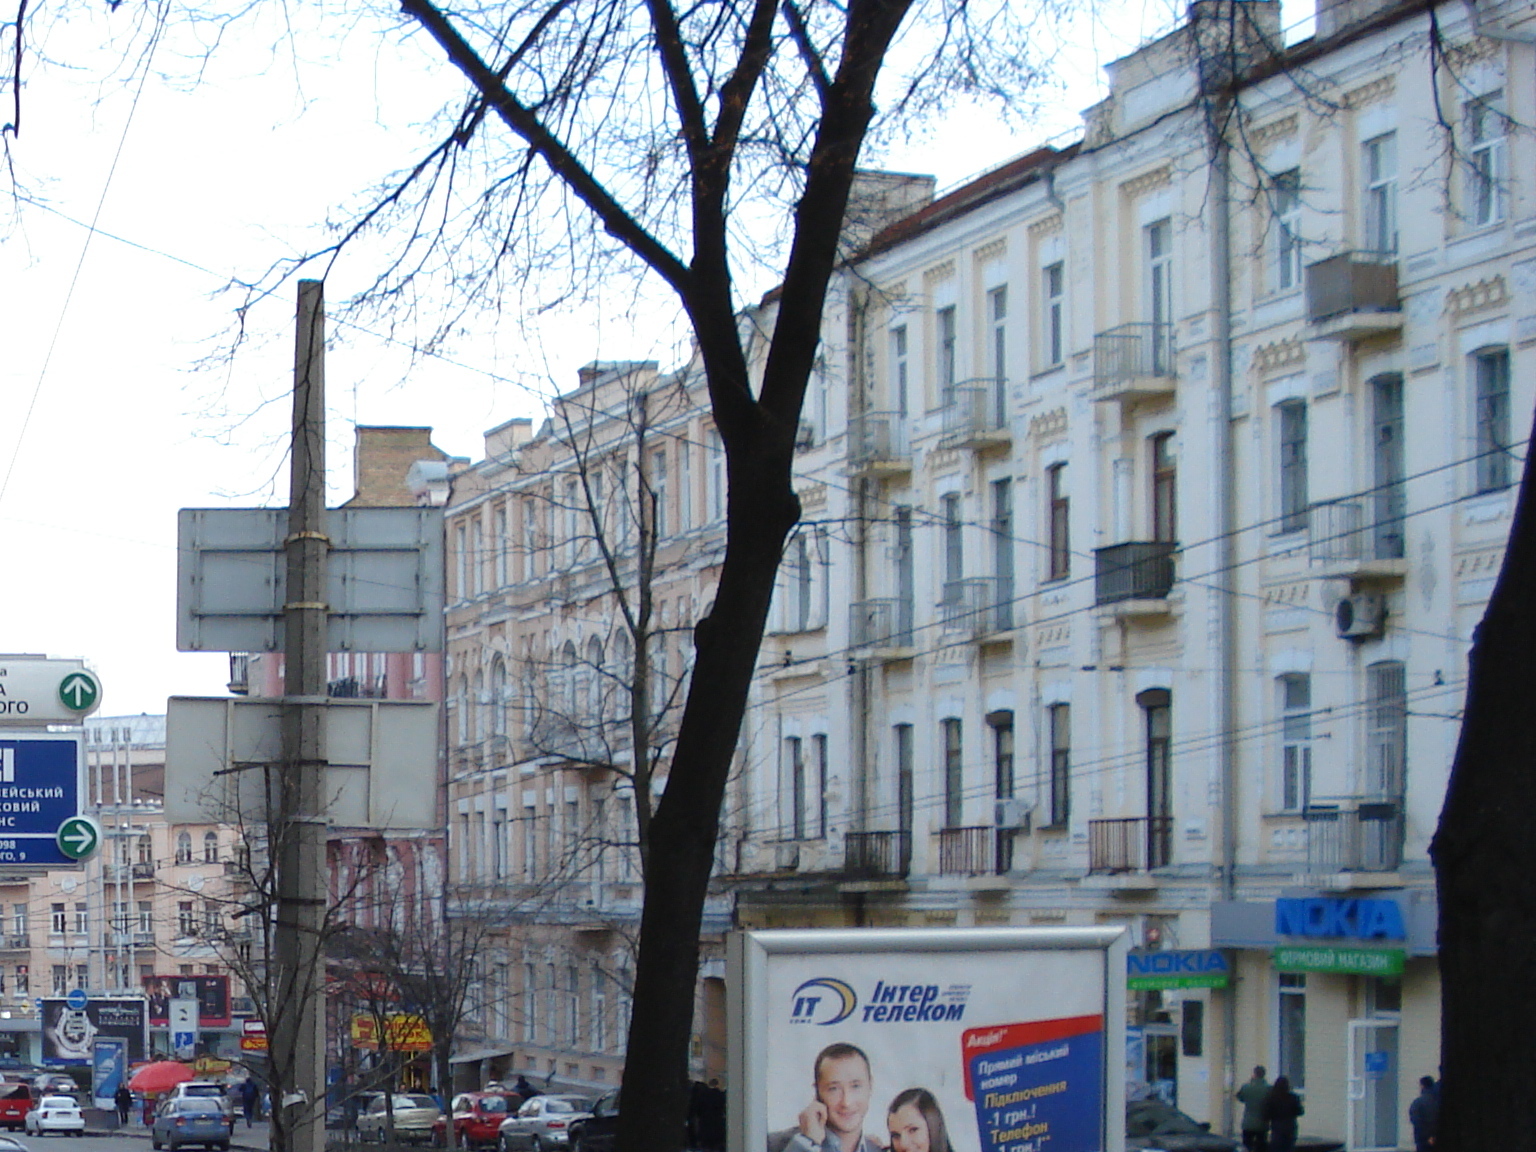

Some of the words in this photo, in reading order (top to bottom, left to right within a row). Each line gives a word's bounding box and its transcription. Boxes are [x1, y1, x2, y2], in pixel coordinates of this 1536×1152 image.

[20, 852, 26, 861] 9
[1276, 898, 1405, 940] NOKIA
[1127, 951, 1228, 974] NOKIA
[872, 980, 939, 1003] Інтер
[862, 1000, 965, 1023] телеком
[978, 1053, 1023, 1076] Прямий
[1025, 1044, 1069, 1065] міський
[981, 1073, 1017, 1090] номер
[984, 1081, 1067, 1109] Підключення
[990, 1122, 1048, 1144] Телефон
